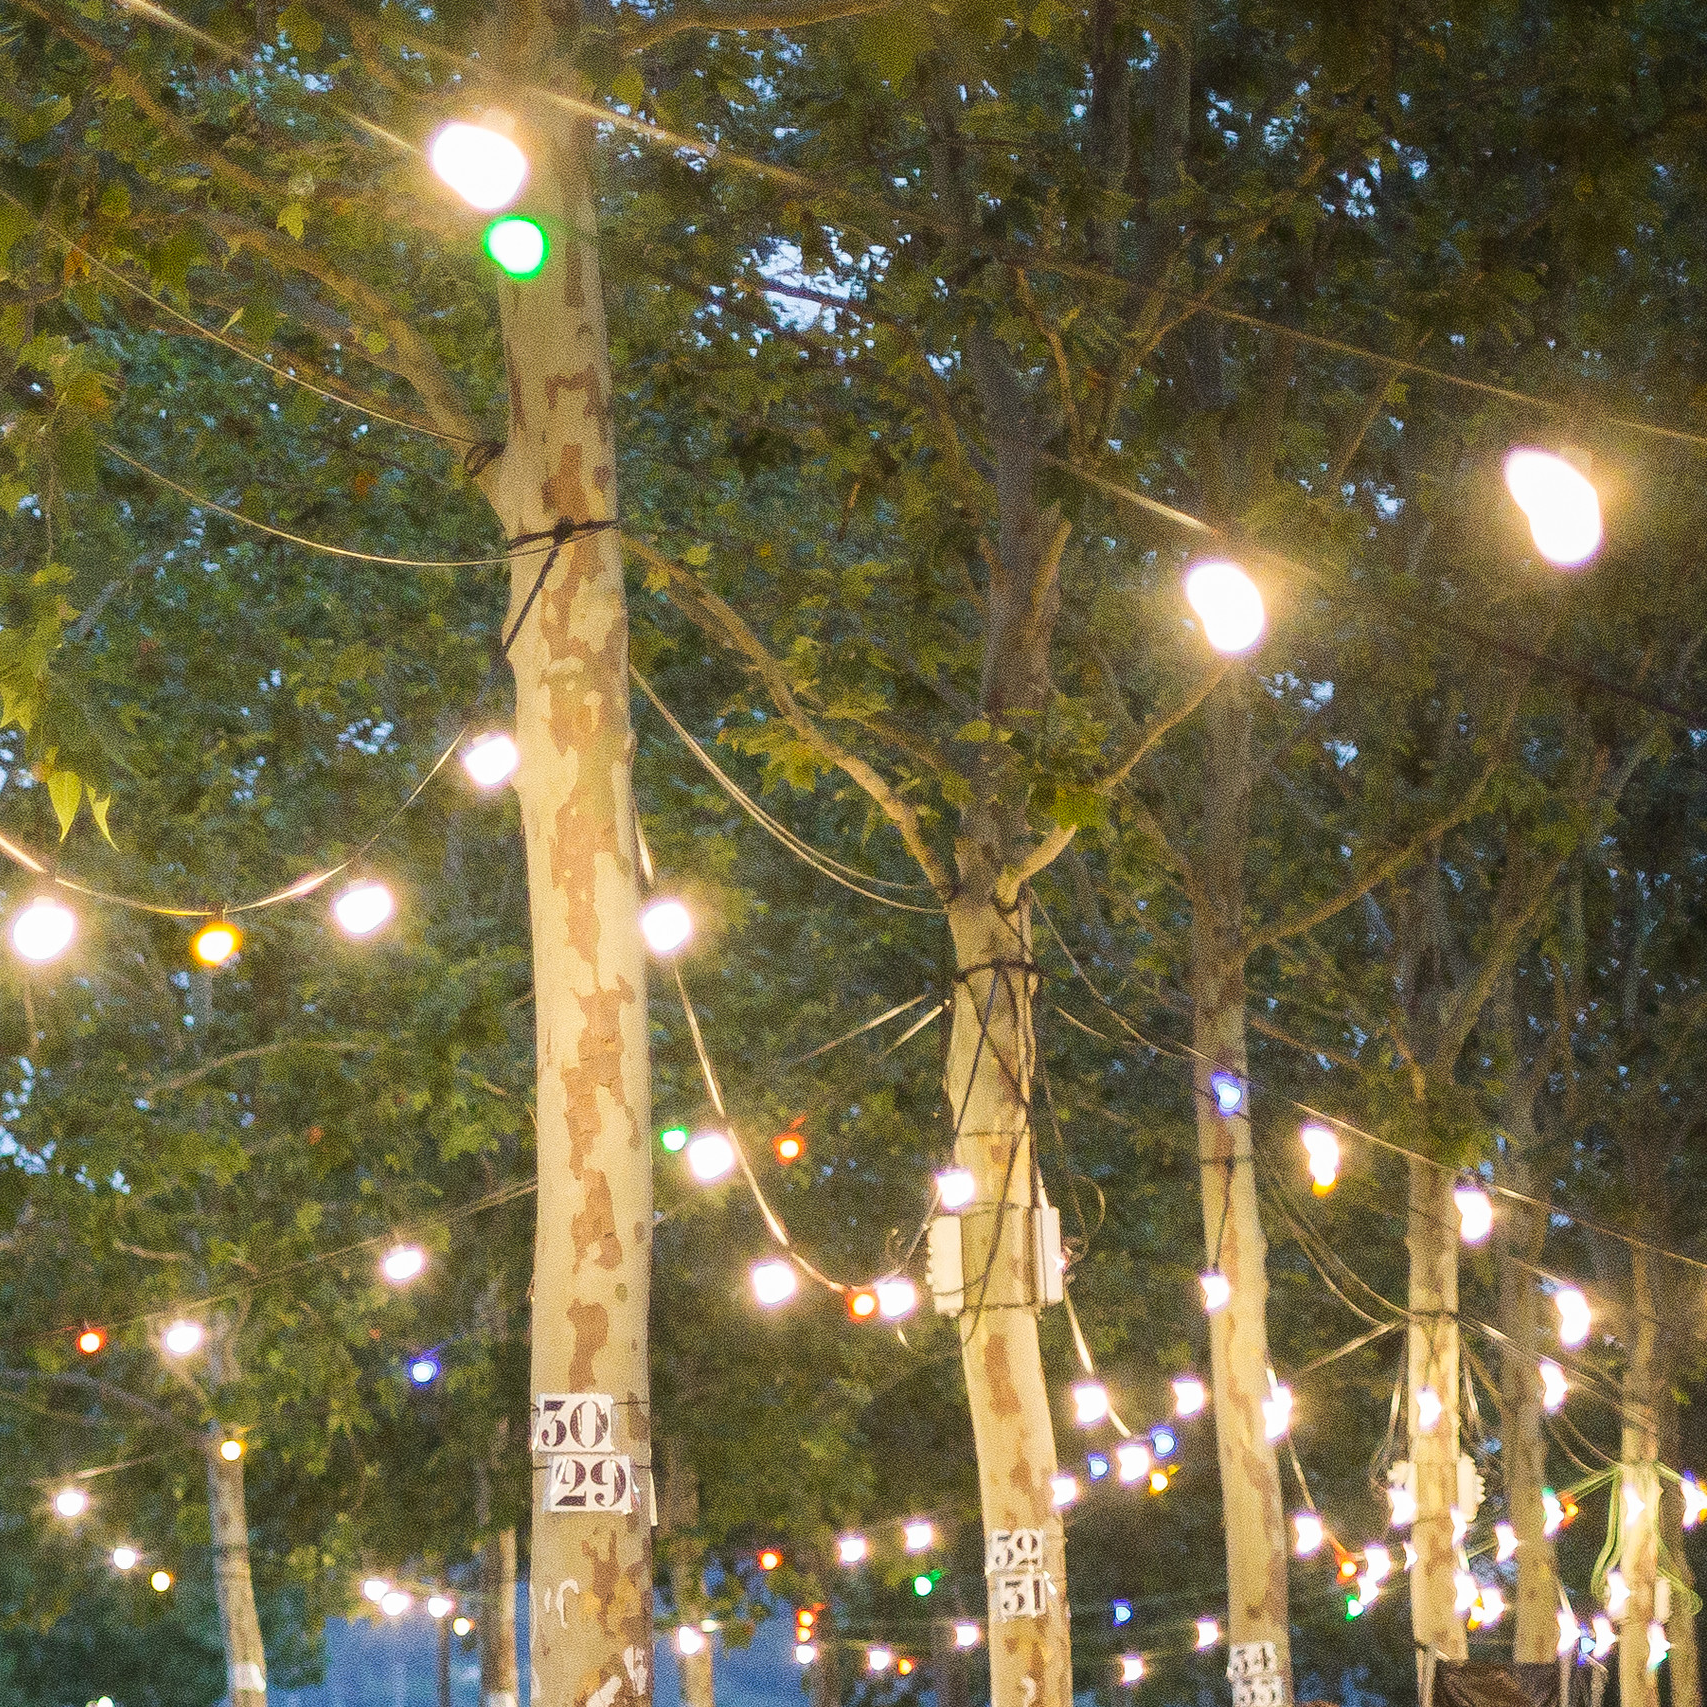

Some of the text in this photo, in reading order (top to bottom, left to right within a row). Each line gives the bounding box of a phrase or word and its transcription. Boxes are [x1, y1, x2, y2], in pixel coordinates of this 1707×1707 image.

[541, 1400, 609, 1448] 30
[555, 1459, 626, 1507] 29
[995, 1534, 1038, 1566] 32
[1003, 1580, 1041, 1612] 31
